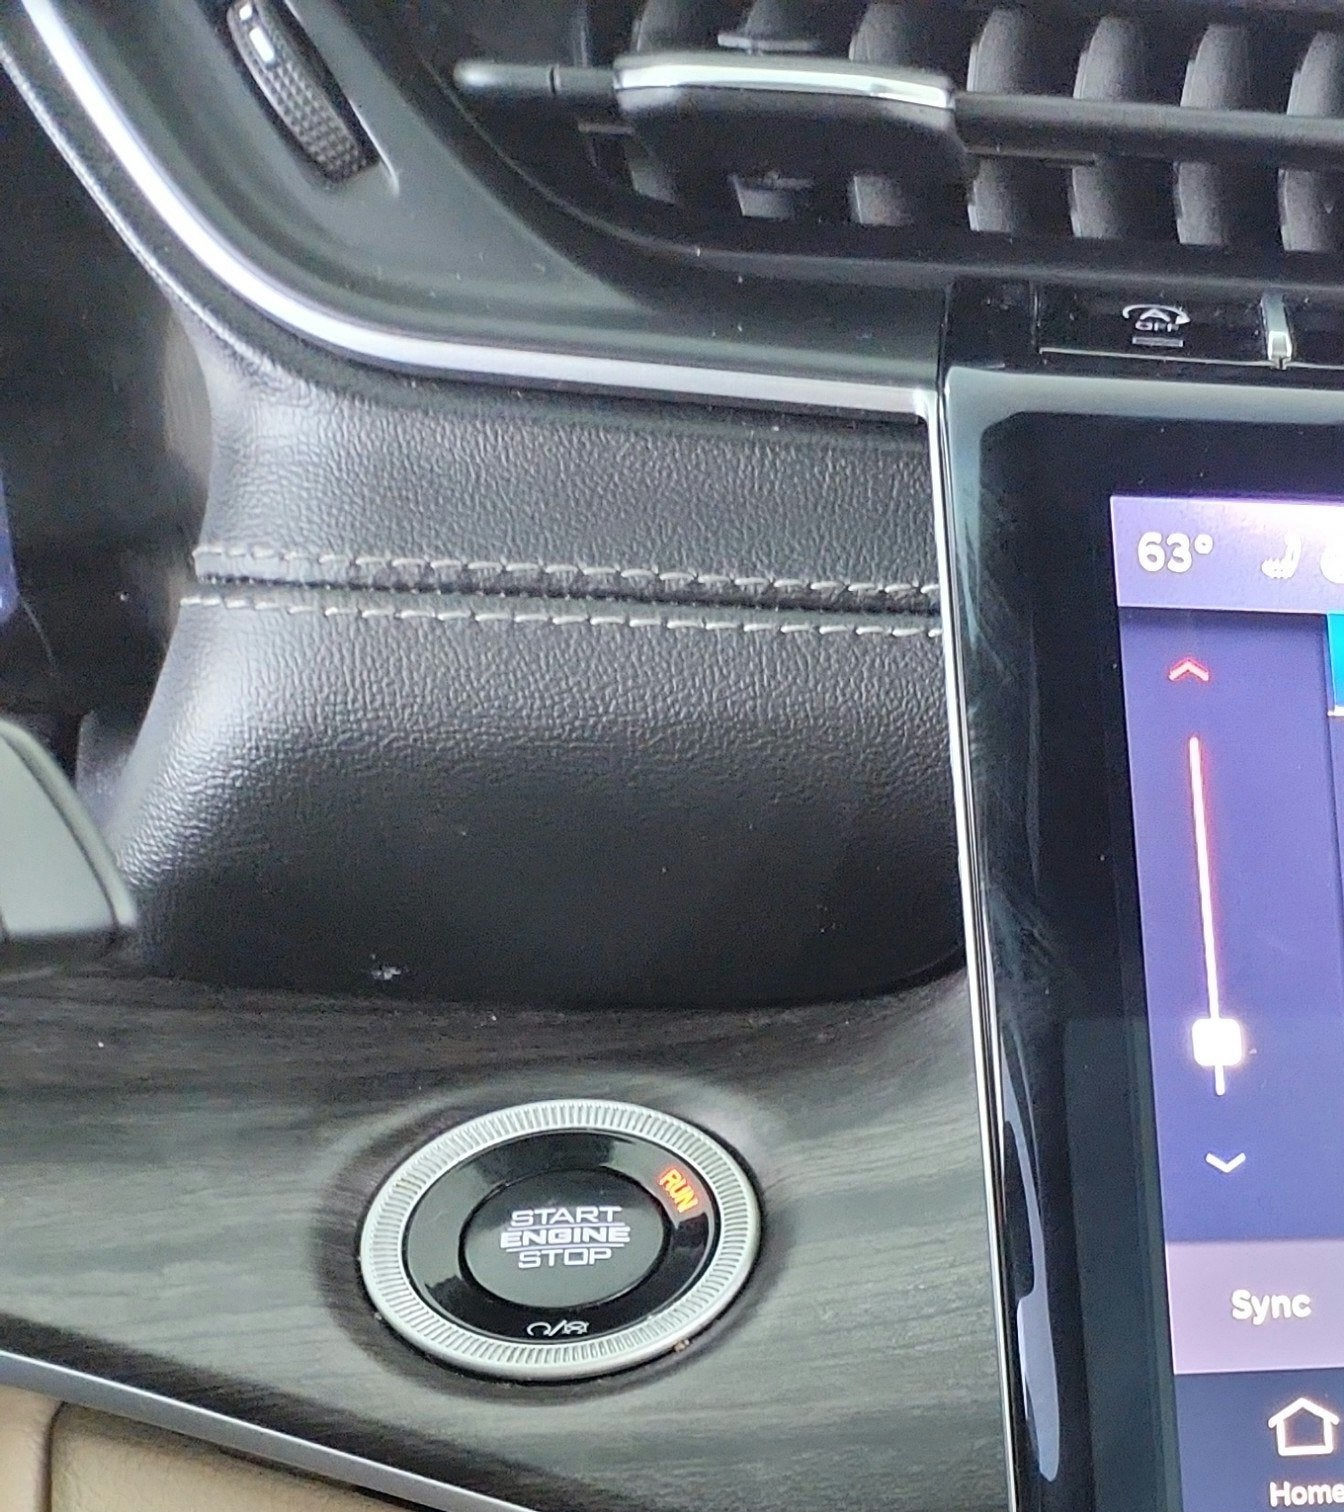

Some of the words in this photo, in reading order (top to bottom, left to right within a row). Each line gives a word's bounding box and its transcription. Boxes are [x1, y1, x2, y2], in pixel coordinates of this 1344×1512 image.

[1136, 532, 1214, 574] 63°
[658, 1168, 699, 1213] RUN
[511, 1205, 623, 1226] START
[500, 1226, 632, 1248] ENGINE
[518, 1247, 613, 1269] STOP
[1231, 1290, 1312, 1326] Sync
